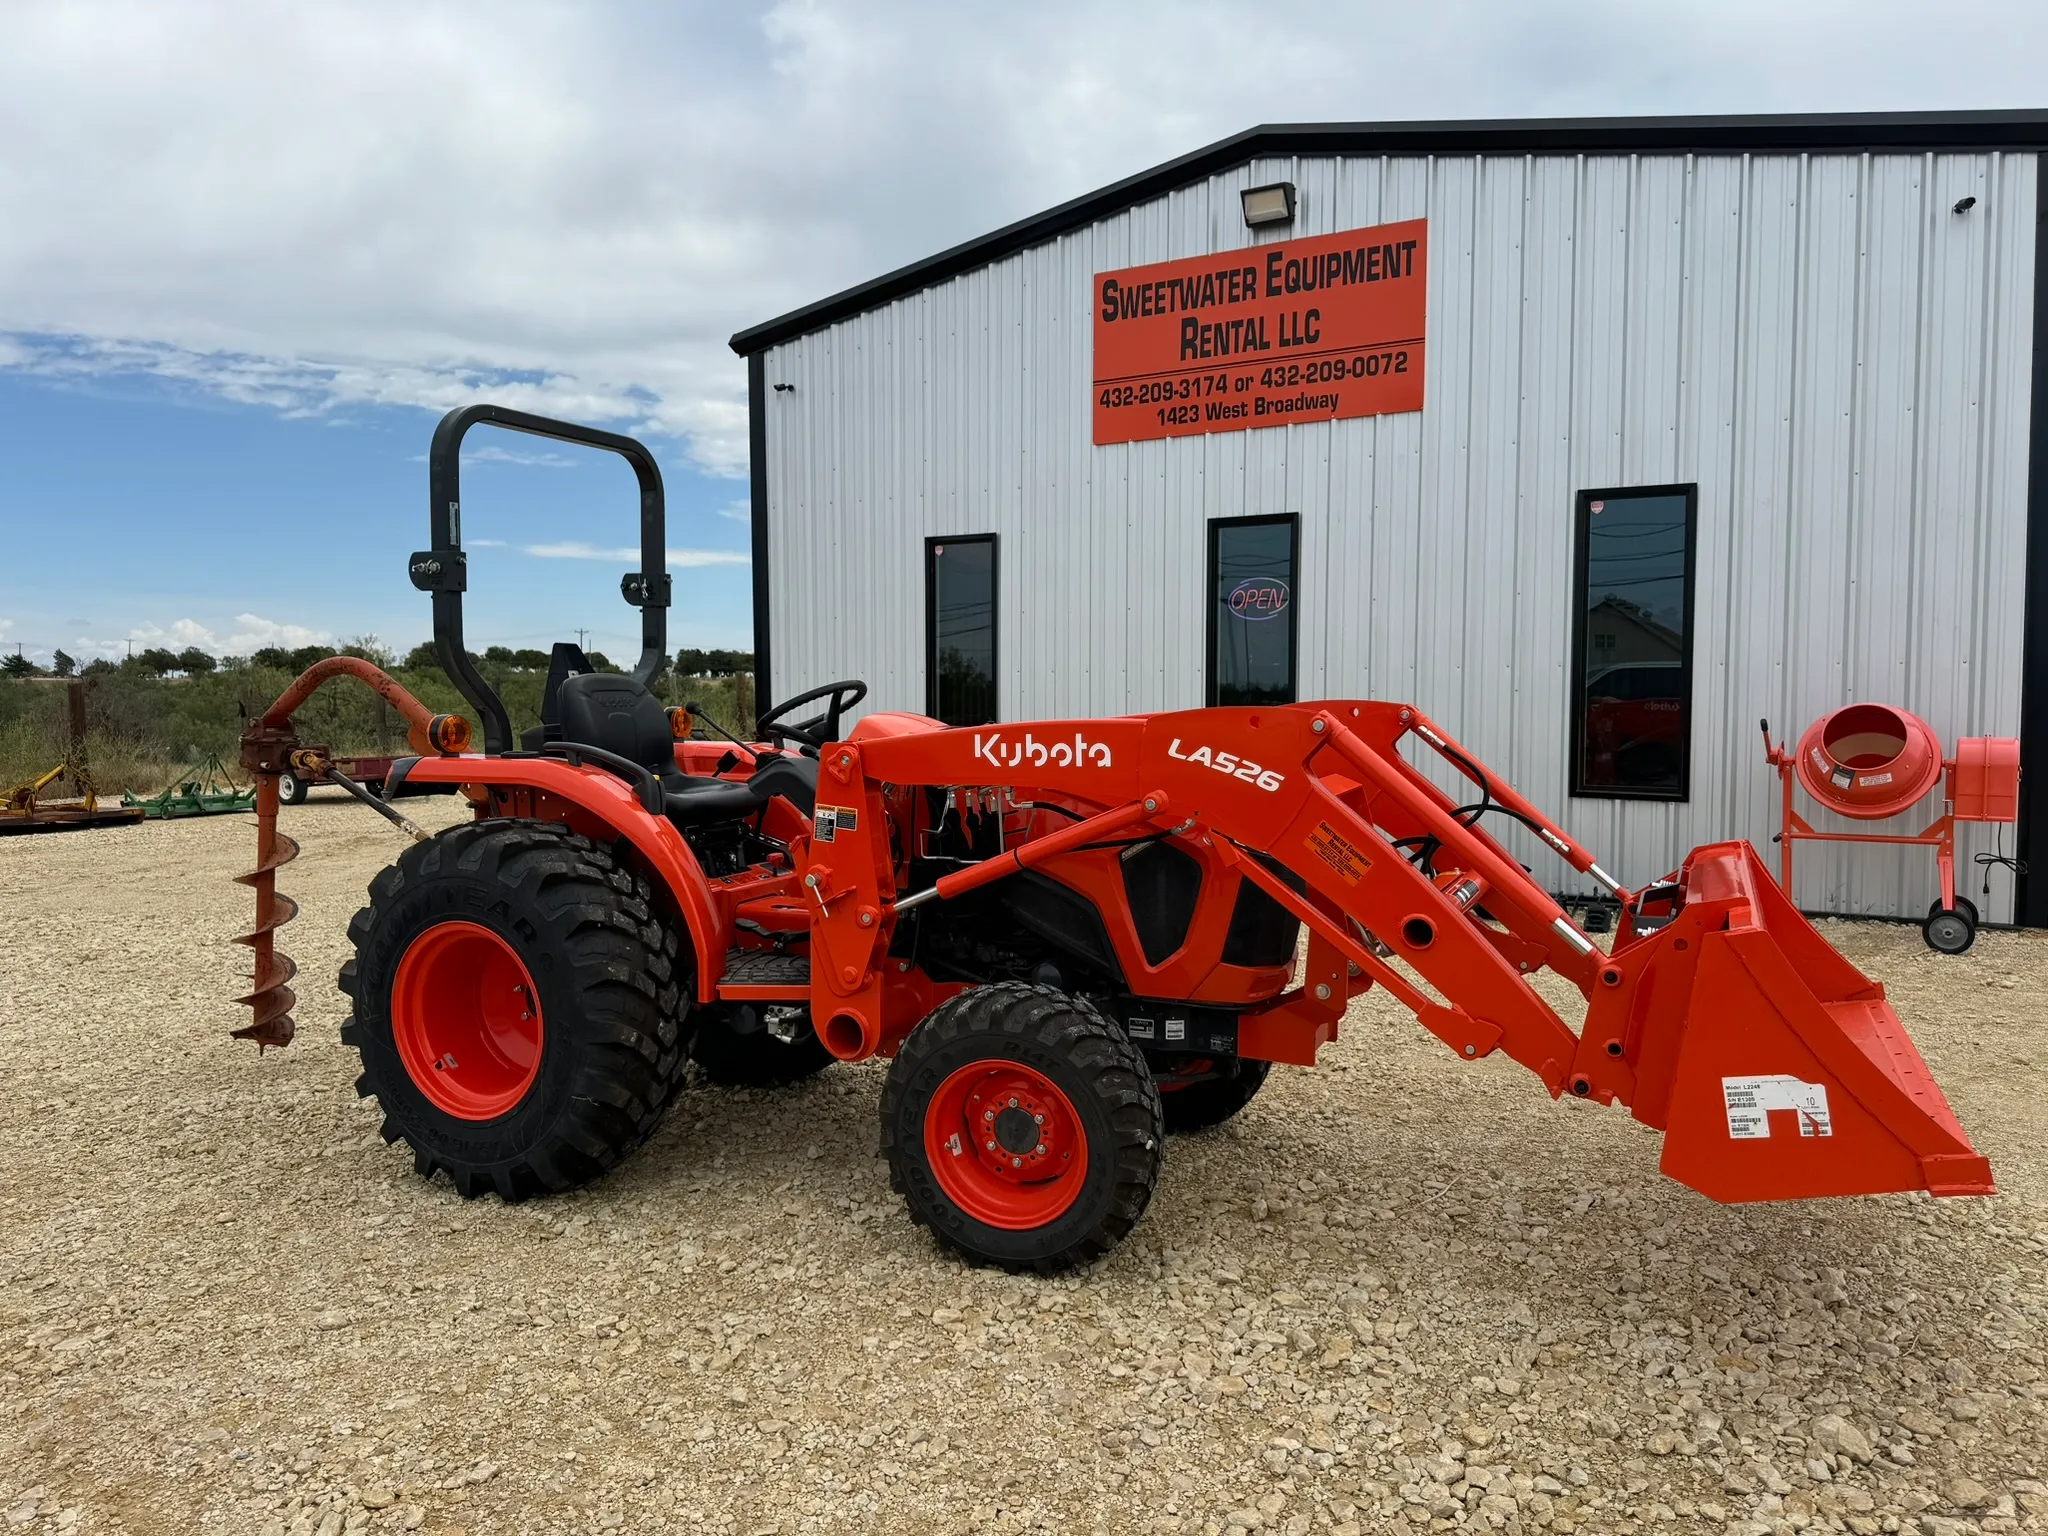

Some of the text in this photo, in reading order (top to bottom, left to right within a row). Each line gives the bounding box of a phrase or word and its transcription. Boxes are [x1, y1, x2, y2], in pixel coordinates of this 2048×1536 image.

[1101, 240, 1417, 322] SWEETWATER EQUIPMENT
[1180, 308, 1320, 361] RENTAL LLC
[1099, 351, 1408, 408] 432-209-3174 or 432-209-0072
[1156, 391, 1339, 426] 1423 West Broadway
[1231, 588, 1285, 610] OPEN
[974, 733, 1112, 767] Kubota
[1167, 738, 1286, 792] LA526
[1805, 1097, 1816, 1106] 10
